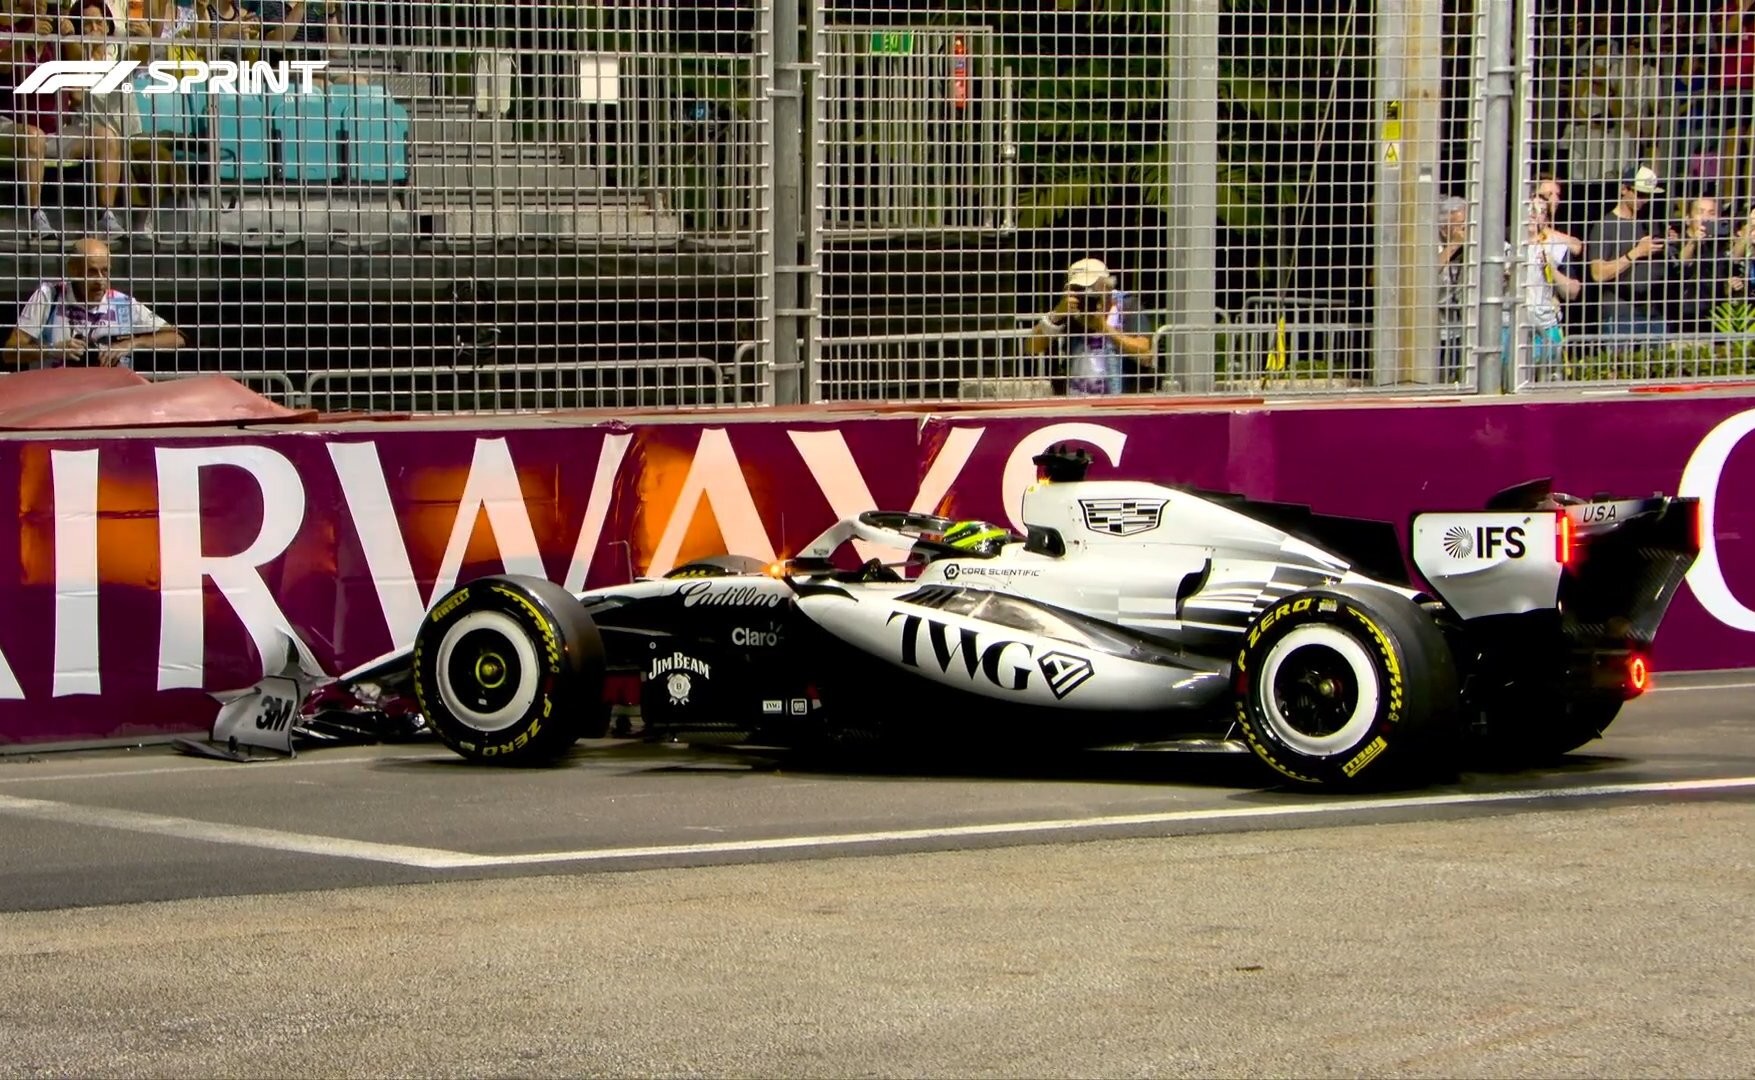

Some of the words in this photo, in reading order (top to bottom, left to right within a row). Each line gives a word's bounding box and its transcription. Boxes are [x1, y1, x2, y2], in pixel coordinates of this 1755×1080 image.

[1583, 505, 1616, 523] USA
[1476, 526, 1526, 559] IFS
[961, 567, 986, 575] CORE
[988, 568, 1040, 577] SCIENTIFIC
[431, 587, 470, 622] PIRELLI
[680, 581, 779, 608] Cadillac
[732, 626, 778, 647] Claro
[886, 610, 1034, 690] TWG
[1237, 649, 1246, 672] P
[1248, 598, 1313, 648] ZERO
[649, 658, 672, 680] JIM
[673, 652, 710, 680] BEAM
[256, 695, 295, 731] 3M
[482, 718, 541, 757] ZERO
[1342, 736, 1387, 778] PIRELLI
